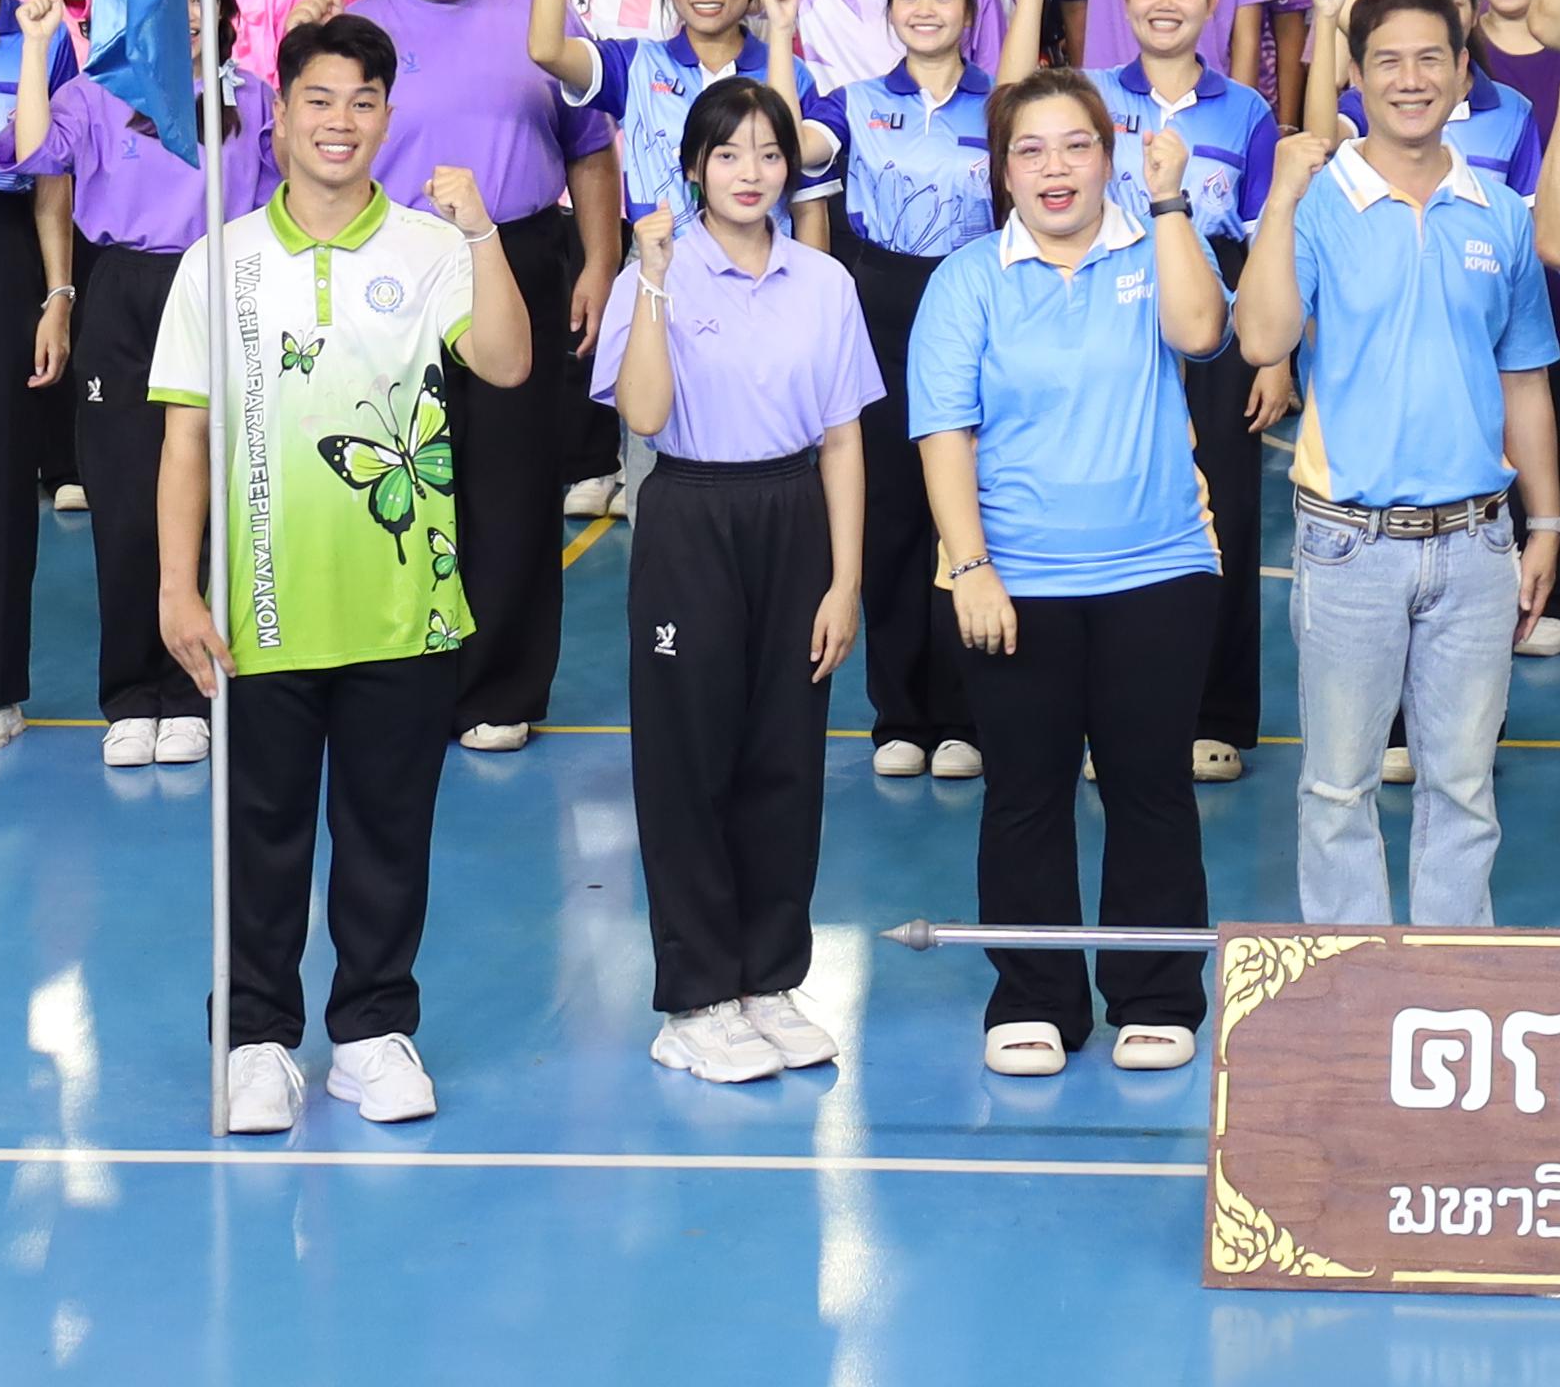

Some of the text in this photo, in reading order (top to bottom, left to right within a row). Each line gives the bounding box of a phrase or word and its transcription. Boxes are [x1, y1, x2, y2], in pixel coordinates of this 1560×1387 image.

[1464, 239, 1493, 256] EDU
[1464, 256, 1501, 274] KPRU
[1116, 267, 1146, 290] EDU
